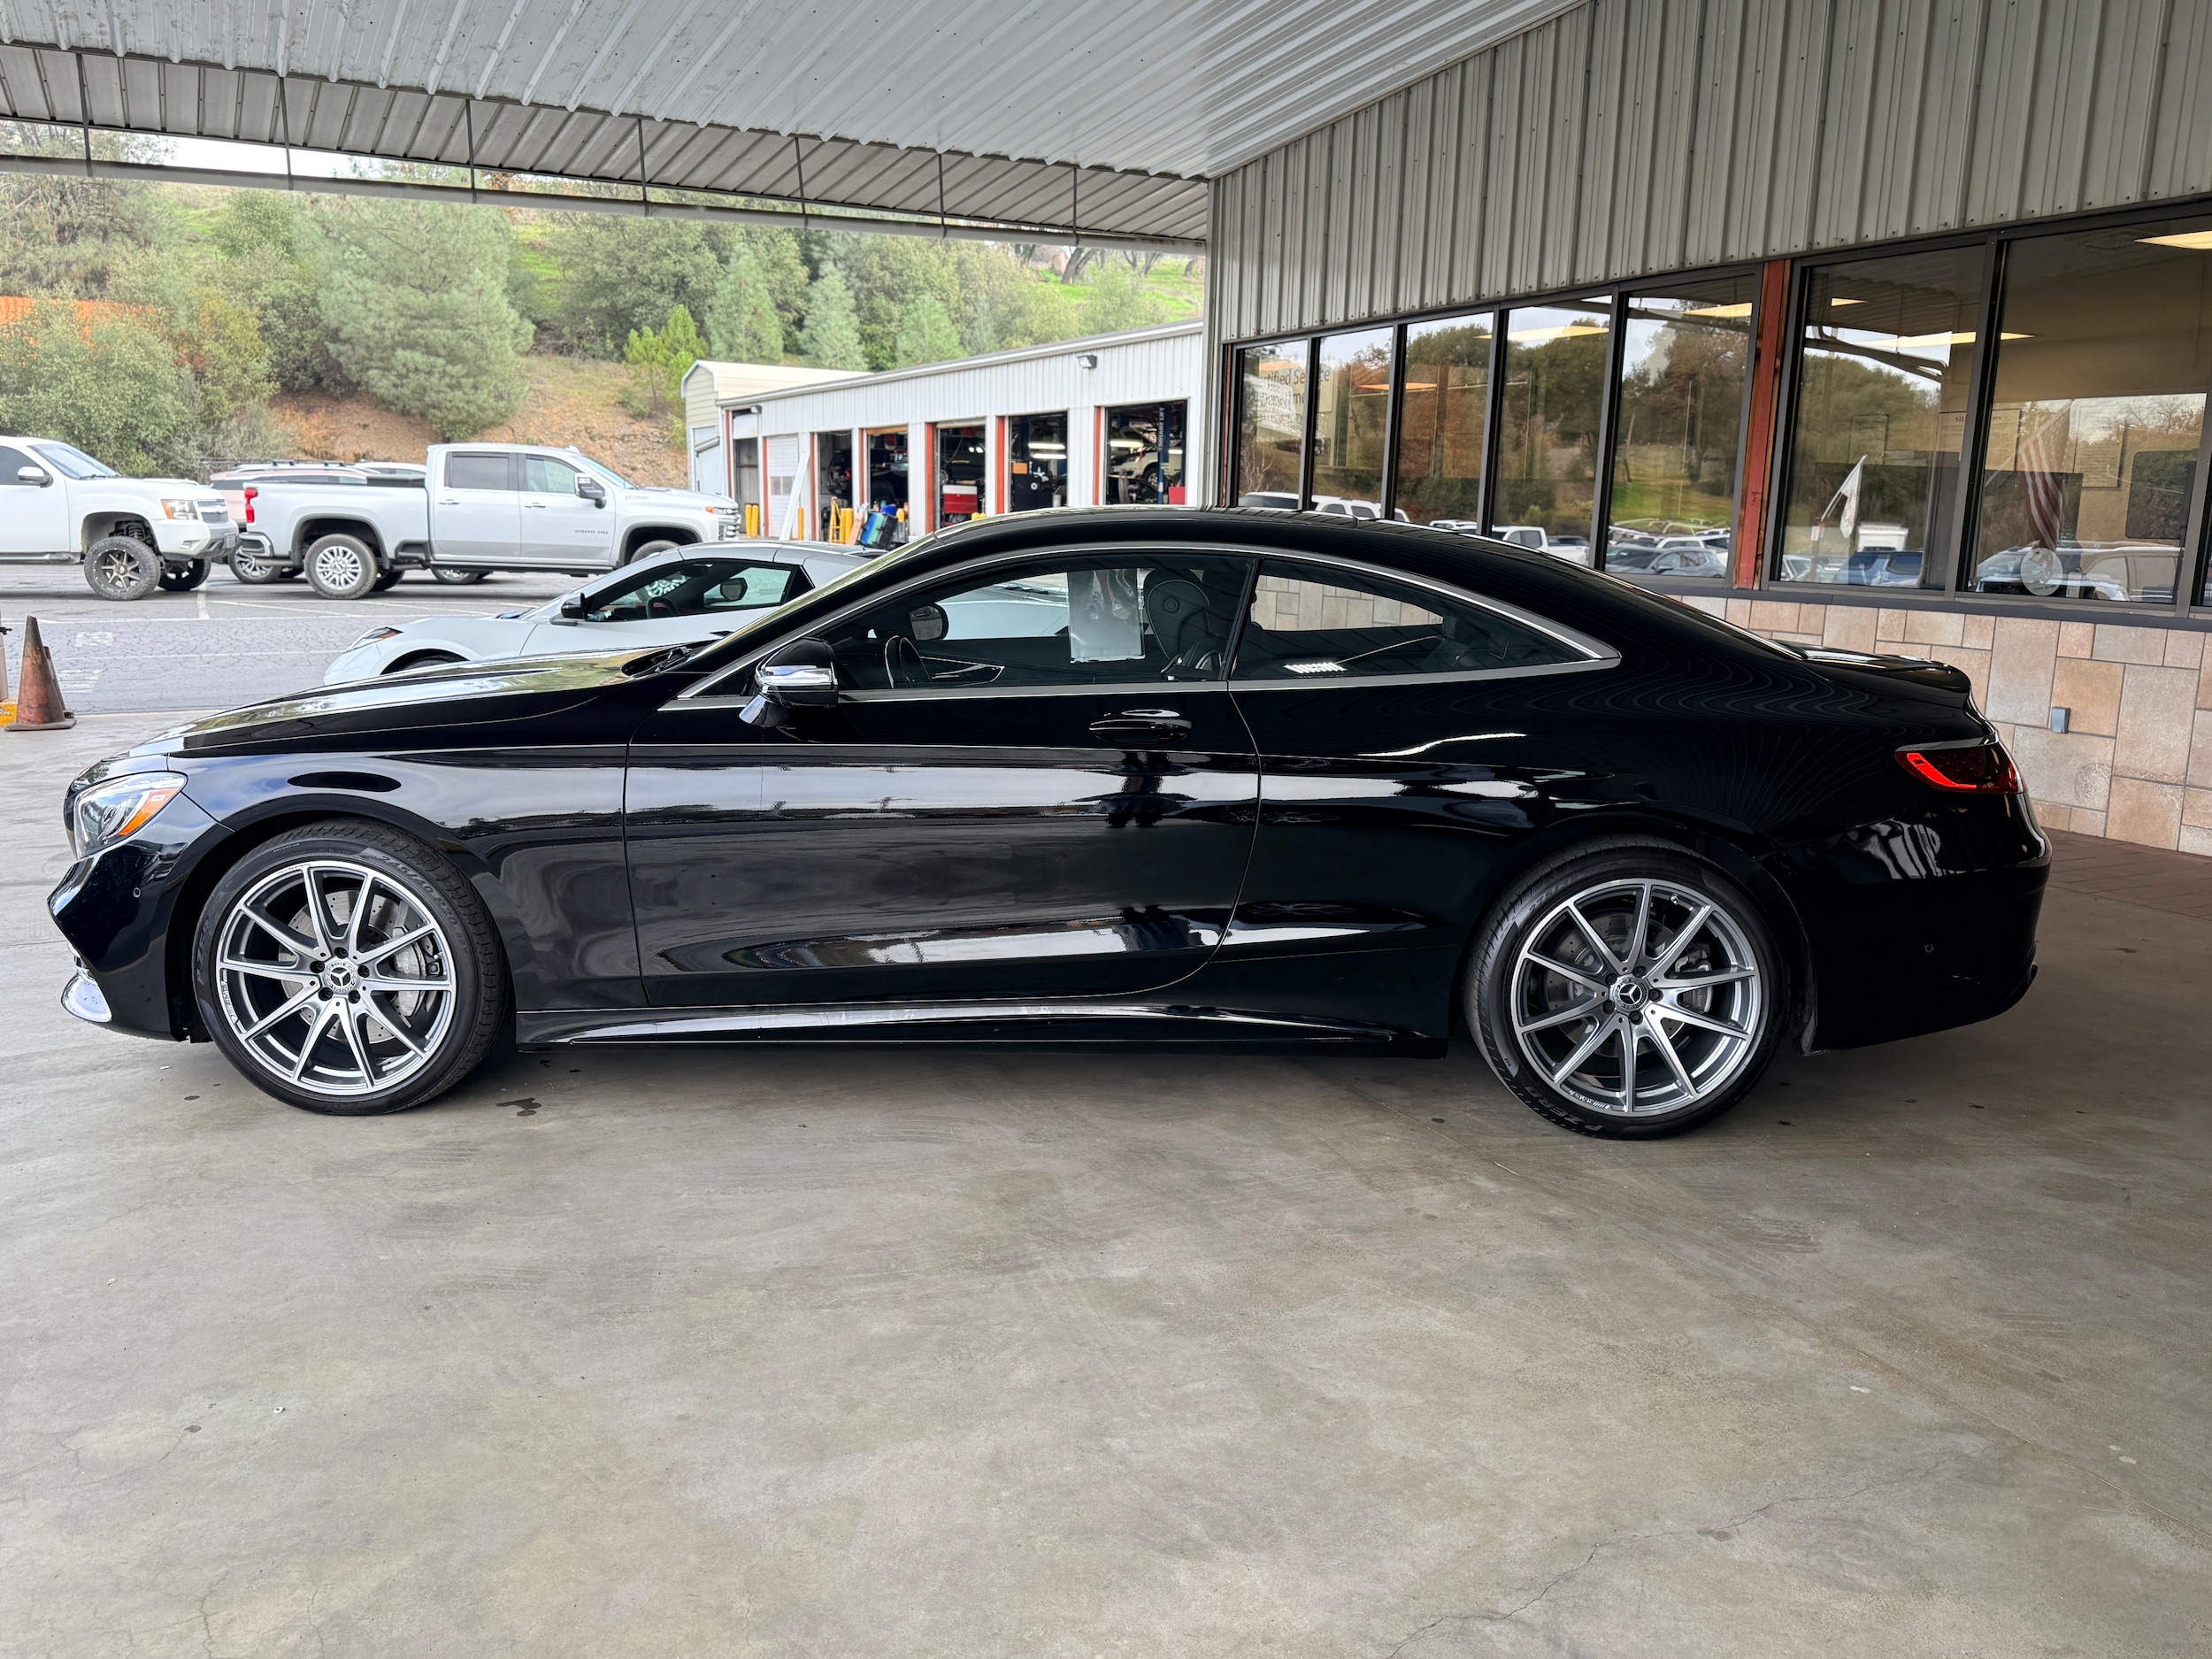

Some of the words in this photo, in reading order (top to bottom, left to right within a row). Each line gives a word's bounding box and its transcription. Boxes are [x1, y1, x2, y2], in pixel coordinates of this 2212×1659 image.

[381, 856, 434, 893] 245/40
[434, 897, 458, 925] R20
[196, 969, 205, 986] P
[1525, 1086, 1584, 1125] ZERO
